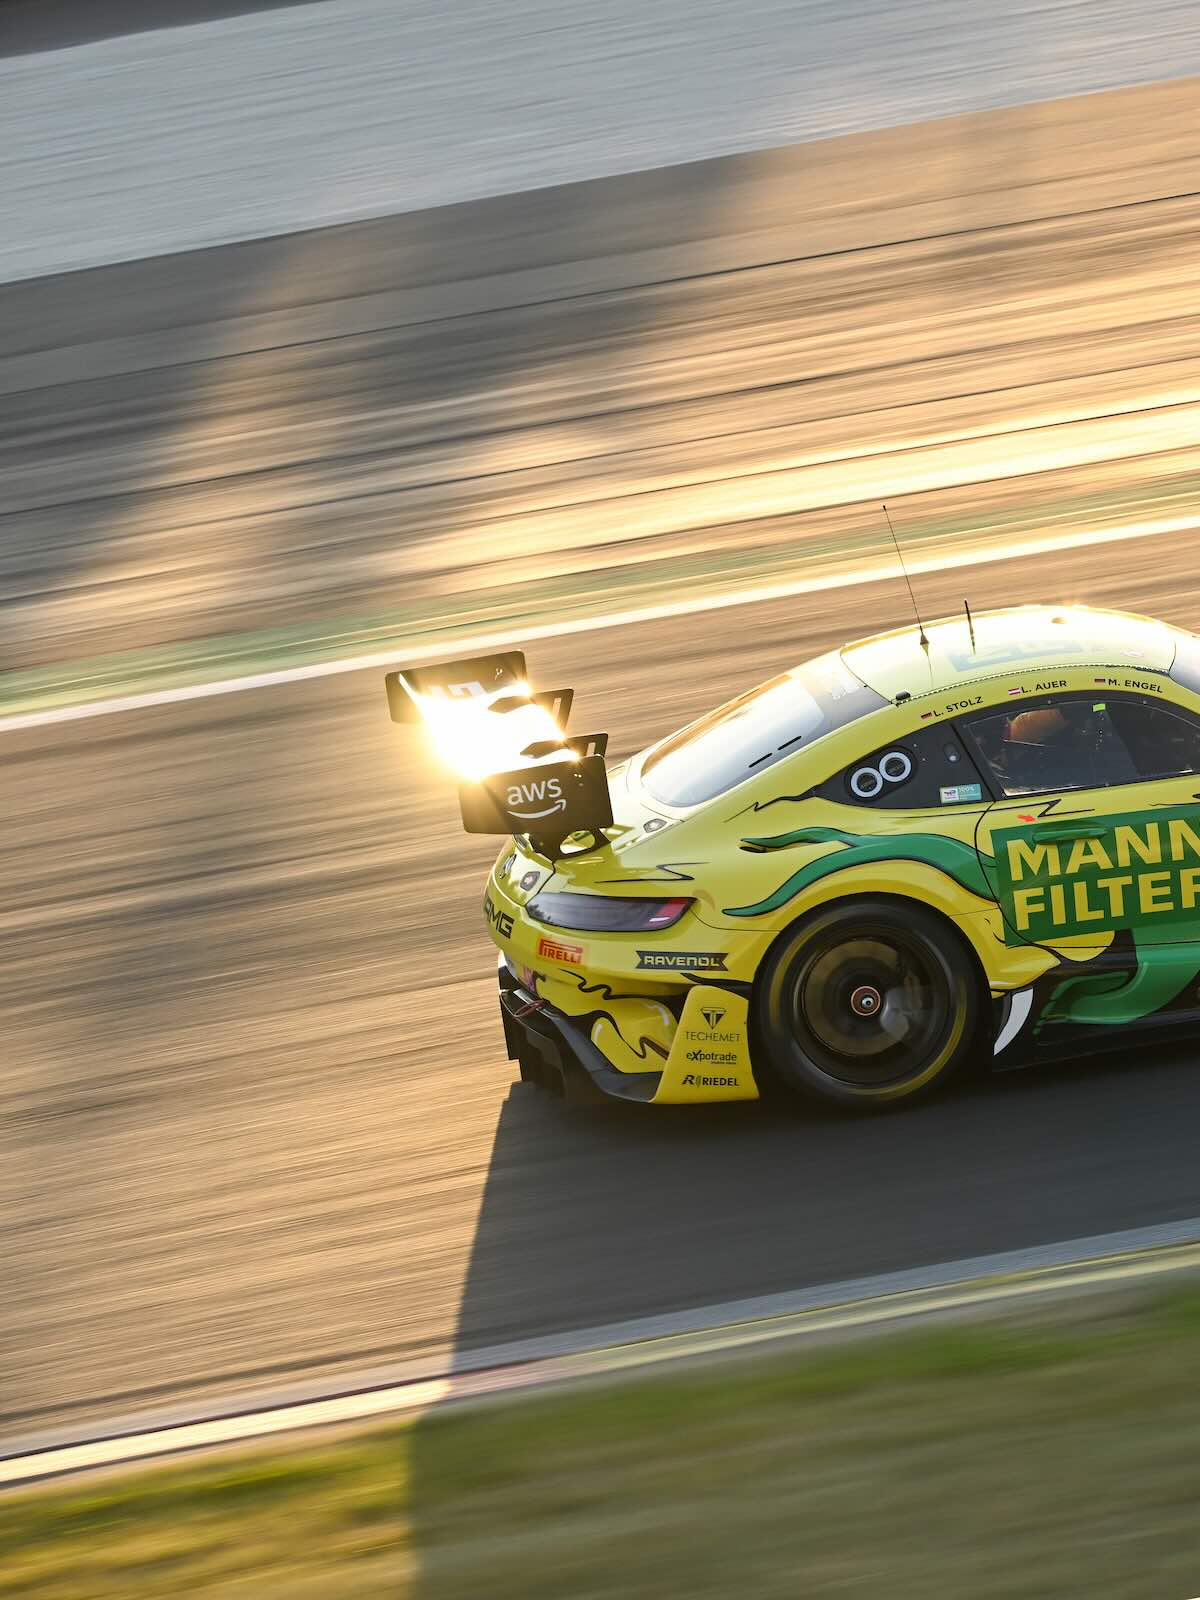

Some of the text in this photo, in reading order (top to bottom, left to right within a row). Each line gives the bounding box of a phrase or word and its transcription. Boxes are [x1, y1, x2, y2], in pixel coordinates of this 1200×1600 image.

[1021, 680, 1067, 694] L. AUER
[1108, 678, 1163, 694] M. ENGEL
[933, 696, 984, 717] L. STOLZ
[507, 778, 562, 806] aws
[539, 938, 584, 965] PIRELLI
[643, 955, 720, 968] RAVENOL
[685, 1031, 741, 1042] TECHEMET
[702, 1077, 740, 1087] RIEDEL
